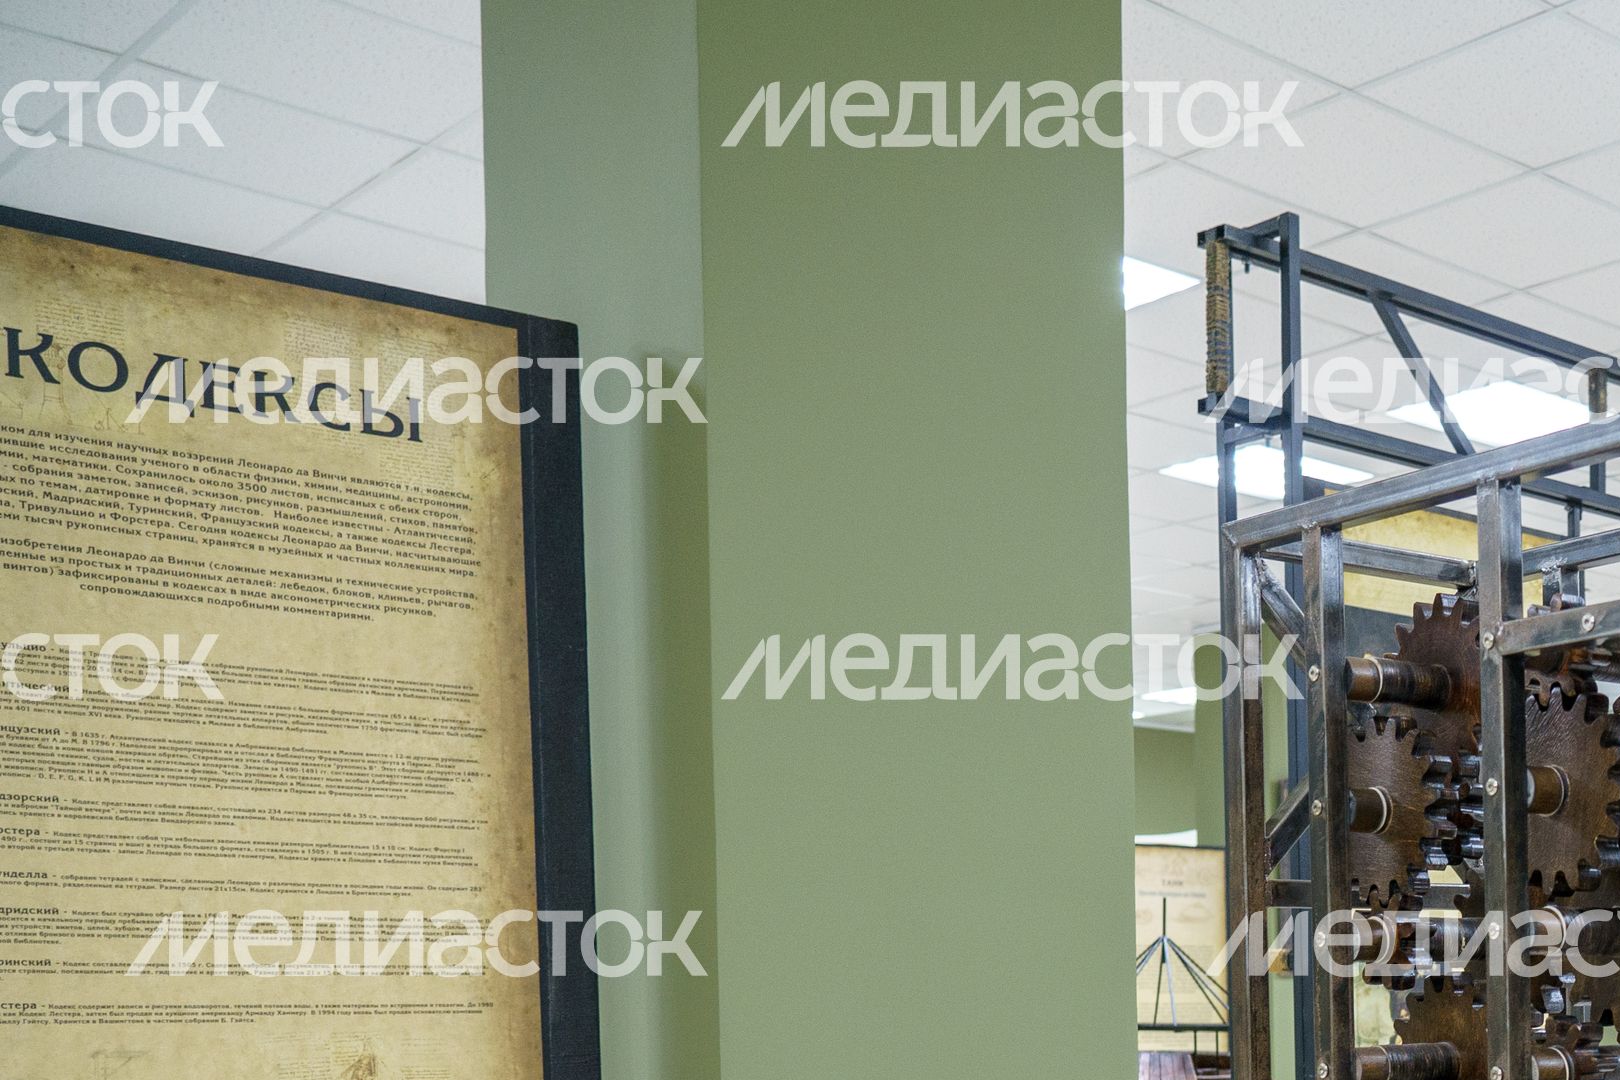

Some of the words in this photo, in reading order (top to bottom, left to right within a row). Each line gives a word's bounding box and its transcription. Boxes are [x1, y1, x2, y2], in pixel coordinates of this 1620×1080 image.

[3, 326, 424, 442] КОДЕКСЫ
[12, 463, 73, 478] собрания
[28, 428, 50, 438] для
[54, 432, 112, 447] изучения
[116, 441, 168, 455] научных
[172, 450, 234, 465] воззрений
[237, 457, 293, 474] Леонардо
[295, 468, 309, 476] да
[312, 468, 346, 481] Винчи
[350, 476, 401, 489] являются
[49, 444, 137, 463] исследования
[140, 457, 189, 470] ученого
[192, 464, 199, 472] в
[202, 465, 250, 479] области
[20, 477, 35, 485] по
[84, 486, 149, 500] датировке
[164, 494, 216, 512] формату
[273, 509, 328, 524] Наиболее
[331, 519, 383, 532] известны
[115, 463, 195, 483] Сохранилось
[198, 477, 233, 488] около
[237, 480, 267, 493] 3500
[316, 494, 376, 508] исписаных
[388, 503, 419, 514] обеих
[20, 499, 94, 518] Тривульцио
[178, 520, 226, 534] Сегодня
[230, 529, 278, 541] кодексы
[282, 533, 336, 549] Леонардо
[395, 550, 481, 567] насчитывающие
[24, 515, 62, 526] тысяч
[66, 520, 141, 536] рукописных
[202, 537, 254, 550] хранятся
[268, 545, 322, 558] музейных
[336, 554, 381, 565] частных
[384, 560, 446, 573] коллекциях
[200, 511, 279, 530] Французский
[346, 532, 378, 542] также
[381, 537, 426, 549] кодексы
[0, 537, 82, 553] изобретения
[86, 545, 146, 561] Леонардо
[149, 555, 164, 563] да
[167, 554, 205, 567] Винчи
[208, 559, 266, 574] (сложные
[269, 569, 332, 582] механизмы
[345, 578, 413, 592] технические
[2, 562, 54, 576] винтов)
[58, 568, 158, 586] зафиксированы
[172, 581, 226, 593] кодексах
[240, 589, 266, 598] виде
[270, 592, 380, 610] аксонометрических
[50, 555, 64, 563] из
[68, 557, 120, 570] простых
[136, 565, 222, 581] традиционных
[226, 575, 276, 587] деталей:
[79, 583, 204, 603] сопровождающихся
[206, 597, 280, 611] подробными
